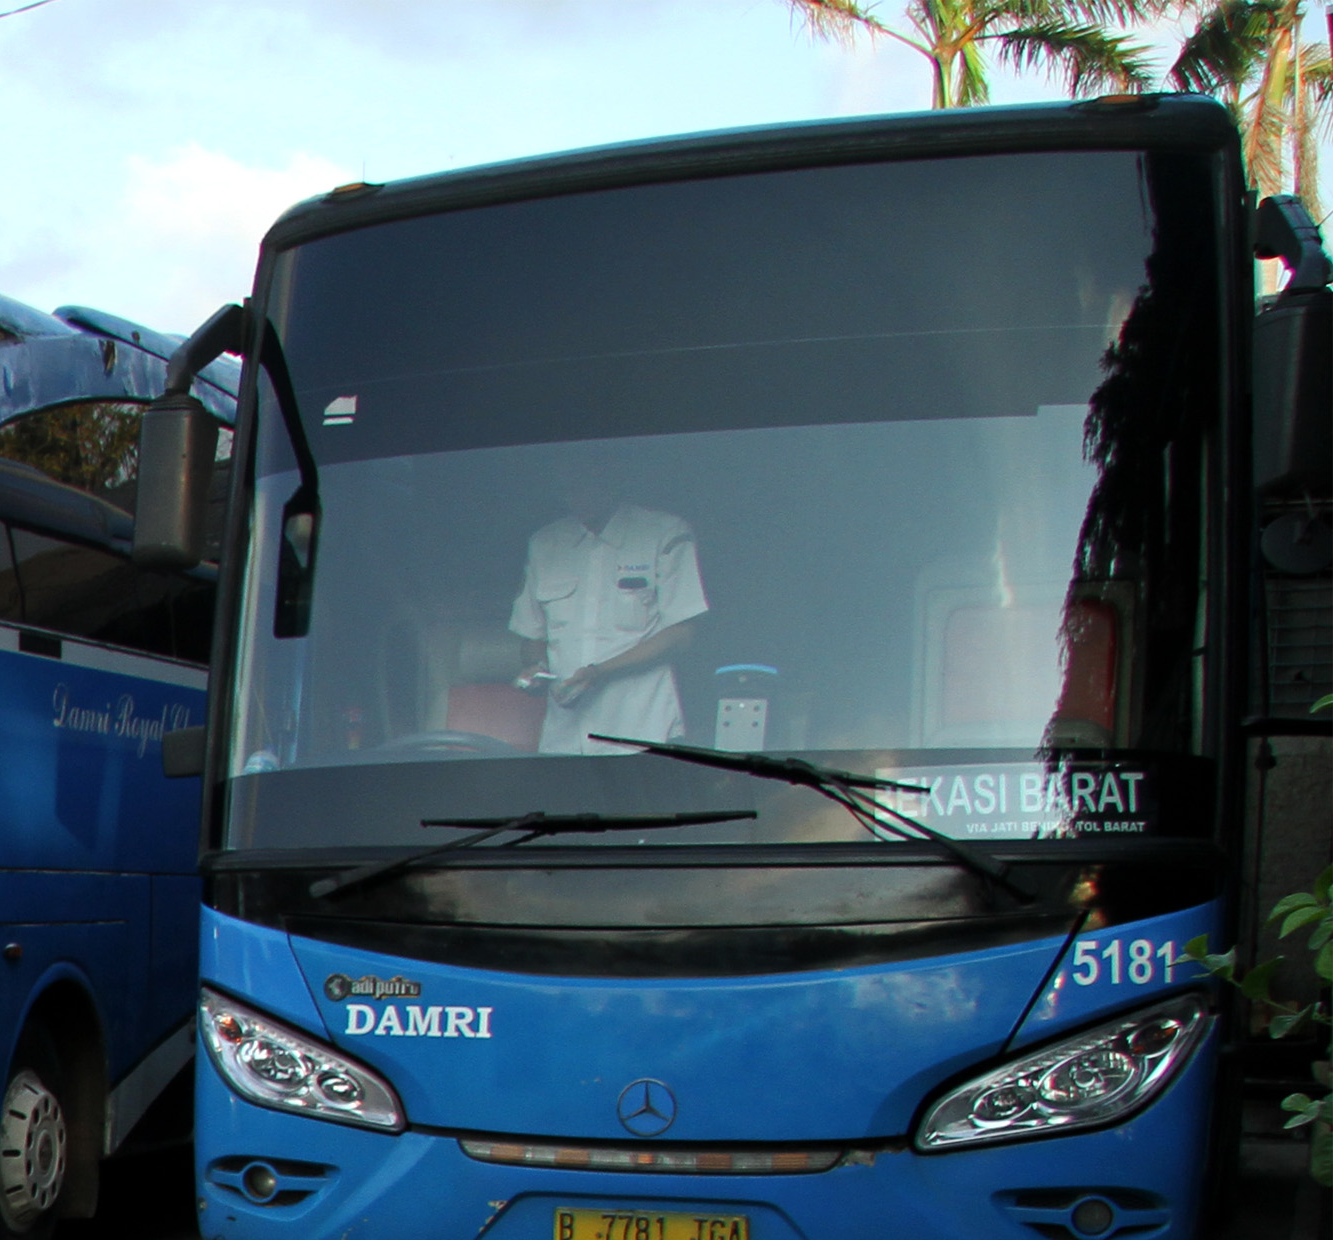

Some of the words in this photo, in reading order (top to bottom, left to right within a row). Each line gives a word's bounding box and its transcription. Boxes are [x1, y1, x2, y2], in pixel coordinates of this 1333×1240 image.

[53, 682, 110, 735] Damri
[115, 693, 168, 759] Royal
[1019, 771, 1144, 814] BARAT
[991, 822, 1017, 832] JATI
[1076, 821, 1101, 832] TOL
[1104, 821, 1146, 832] BARAT
[1072, 939, 1174, 986] 5181
[344, 1004, 493, 1039] DAMRI
